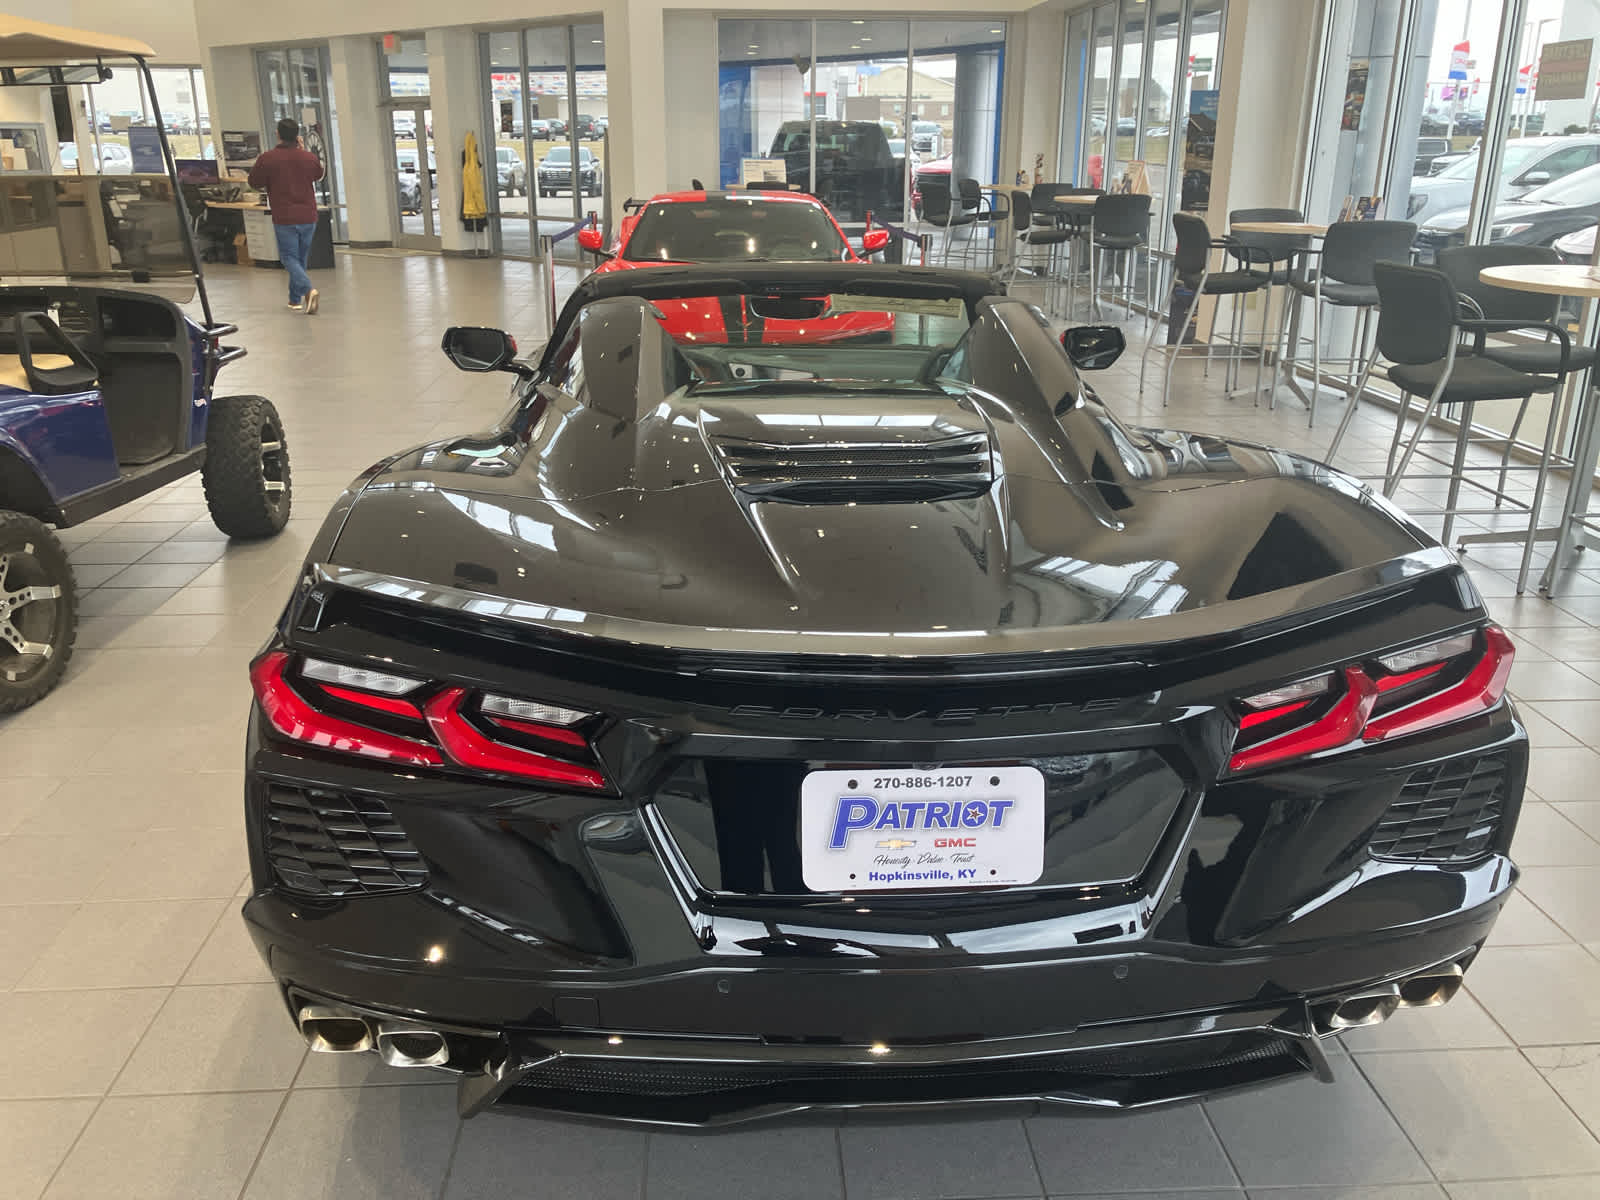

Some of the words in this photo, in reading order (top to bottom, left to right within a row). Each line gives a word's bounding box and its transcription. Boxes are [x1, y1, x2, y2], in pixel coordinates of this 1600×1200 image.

[728, 697, 1122, 722] CORVETTE
[873, 775, 973, 789] 270-886-1207
[828, 796, 1015, 849] PATRIOT
[934, 838, 977, 848] GMC
[873, 854, 911, 869] Honesty
[950, 852, 976, 864] Trust
[868, 871, 953, 883] Hopkinsville,
[958, 868, 977, 879] KY
